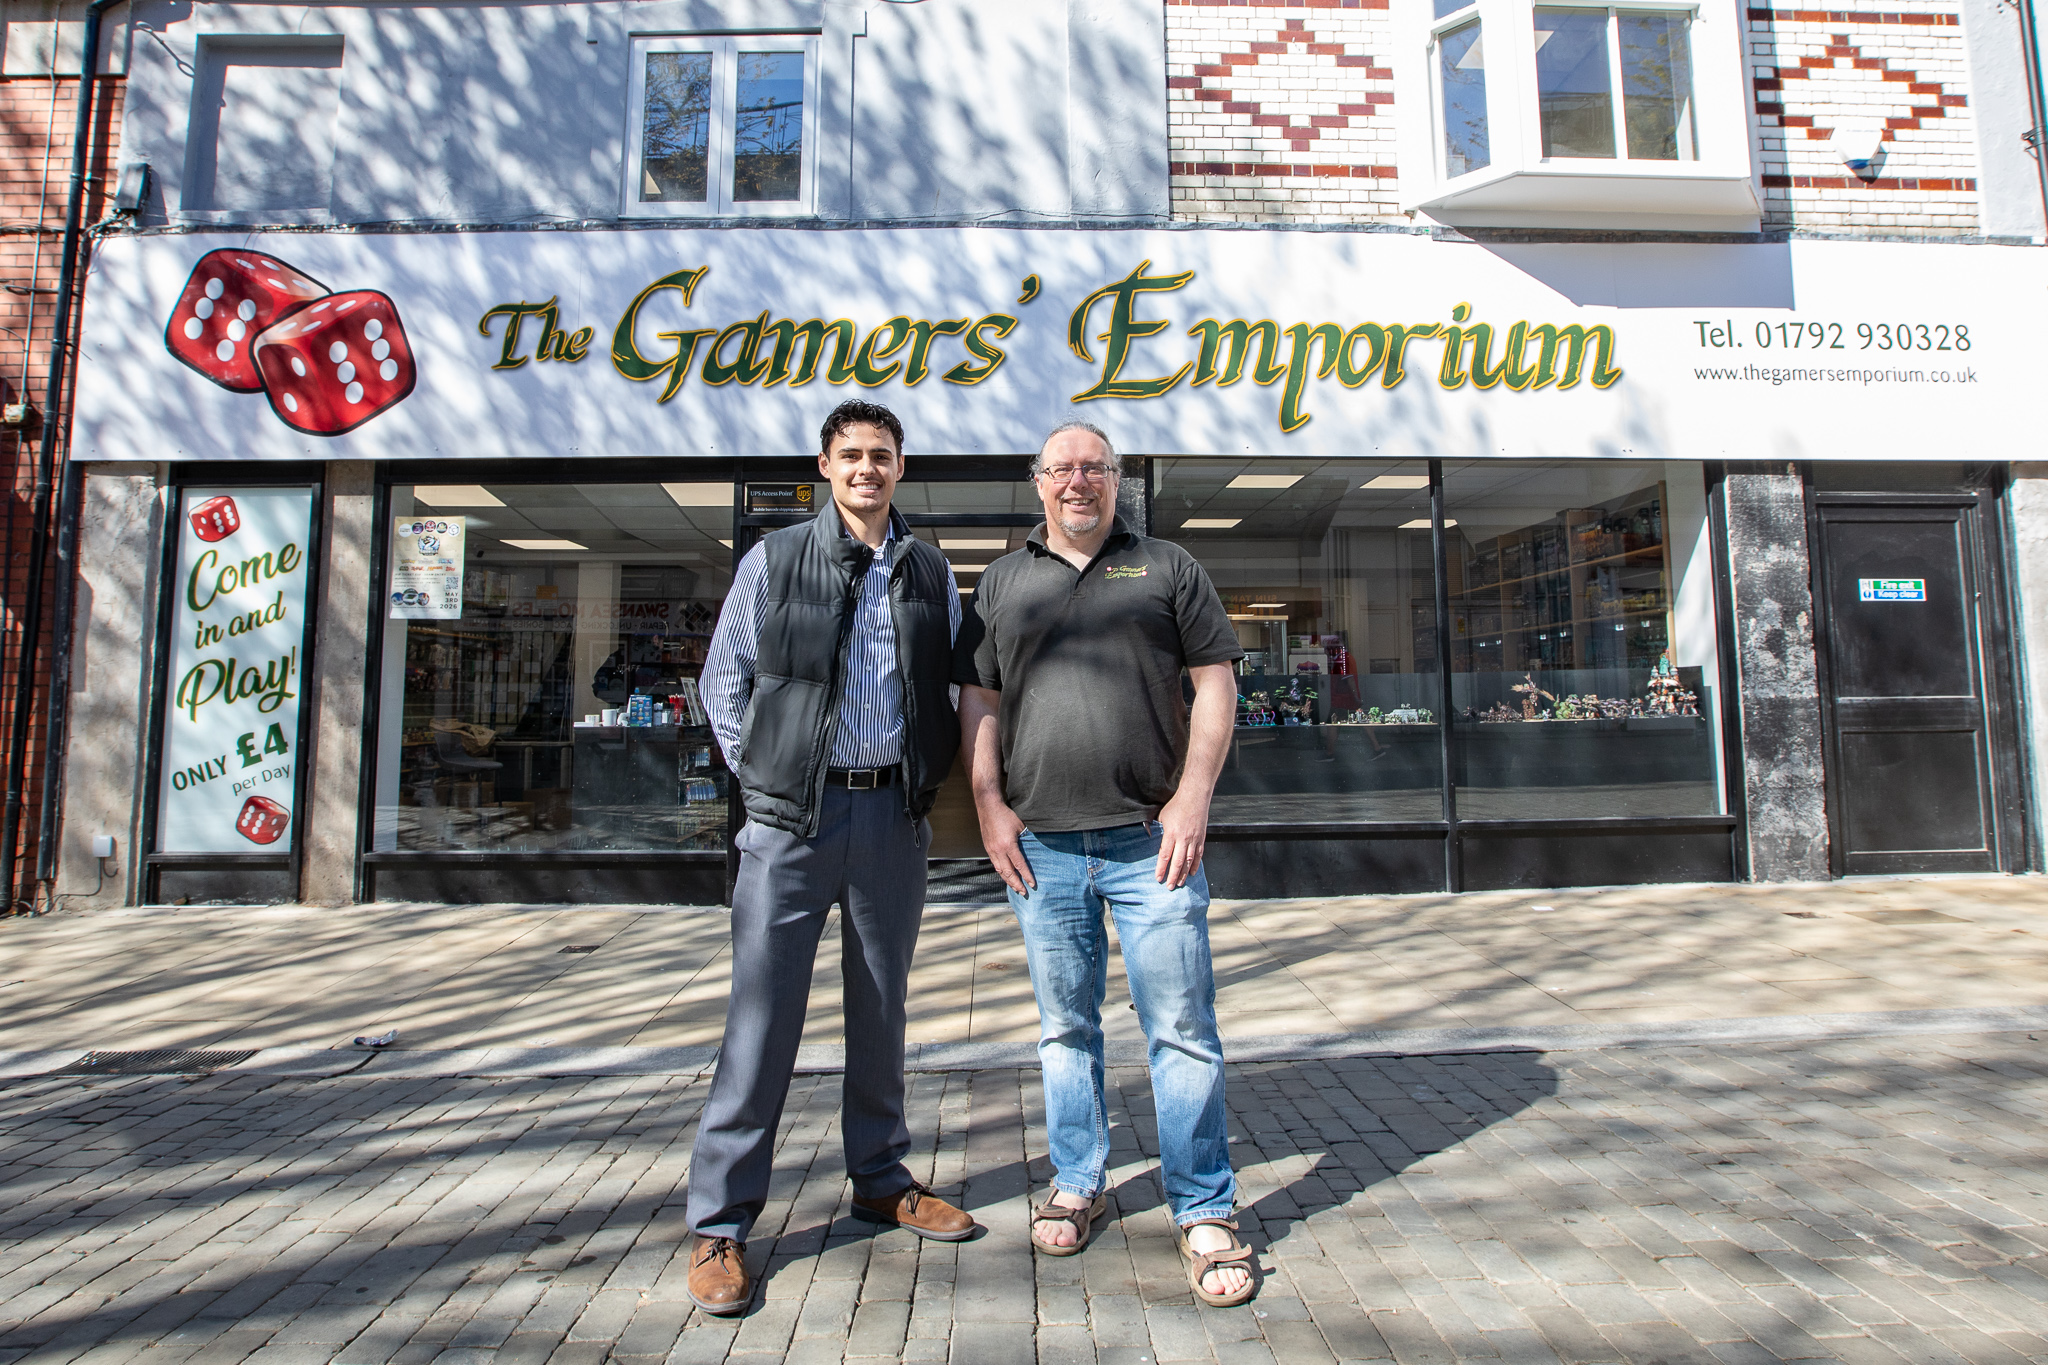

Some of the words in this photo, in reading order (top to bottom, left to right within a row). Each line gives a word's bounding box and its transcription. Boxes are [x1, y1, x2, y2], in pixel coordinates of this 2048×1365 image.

[479, 295, 595, 371] The
[1068, 259, 1622, 432] Emporium
[1693, 319, 1743, 348] Tel.
[1755, 321, 1845, 349] 01792
[1856, 323, 1972, 351] 930328
[1693, 363, 1978, 386] www.thegamersemporium.co.uk
[187, 543, 302, 612] Come
[194, 620, 224, 650] in
[228, 590, 287, 638] and
[176, 645, 296, 723] Play!
[172, 754, 228, 792] ONLY
[235, 722, 289, 769] £4
[232, 775, 257, 796] per
[263, 763, 291, 789] Day
